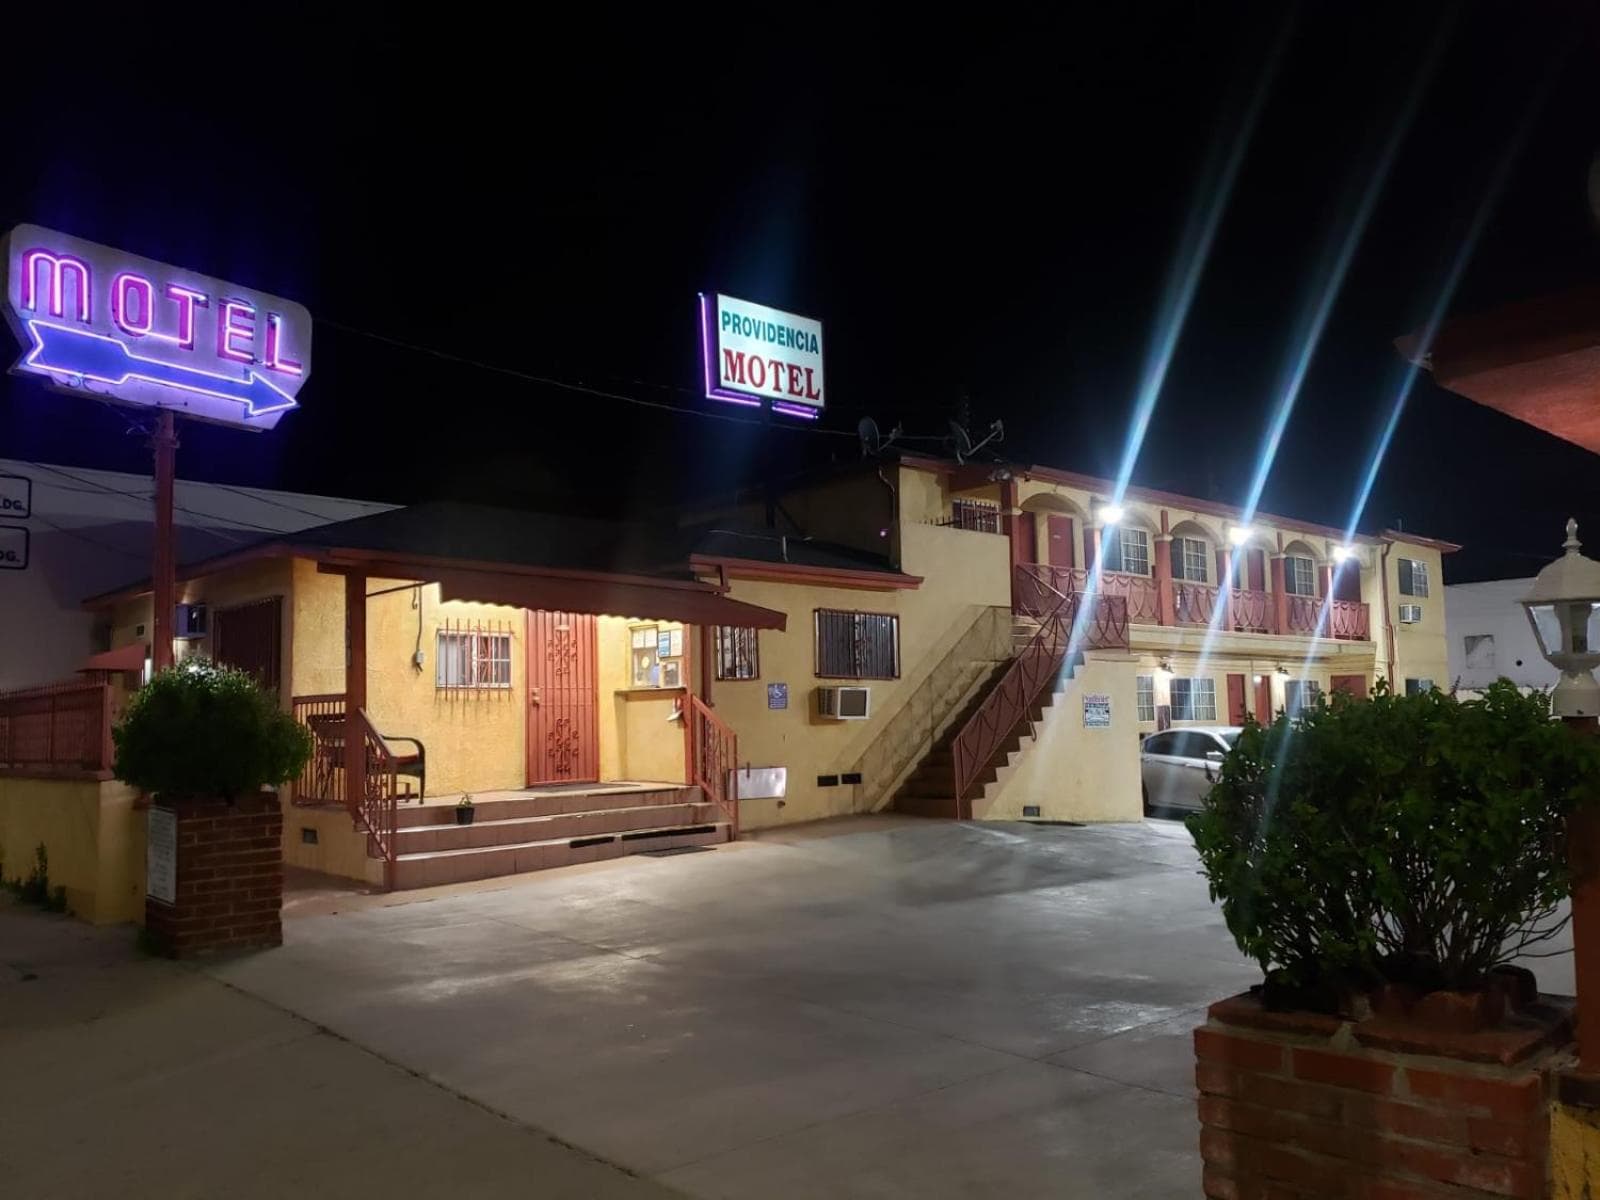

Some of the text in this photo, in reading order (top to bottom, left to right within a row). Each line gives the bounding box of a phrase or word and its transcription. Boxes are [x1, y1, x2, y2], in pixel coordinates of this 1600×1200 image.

[20, 247, 302, 379] MOTEL
[721, 310, 819, 355] PROVIDENCIA
[722, 348, 820, 400] MOTEL
[0, 498, 26, 511] DG.
